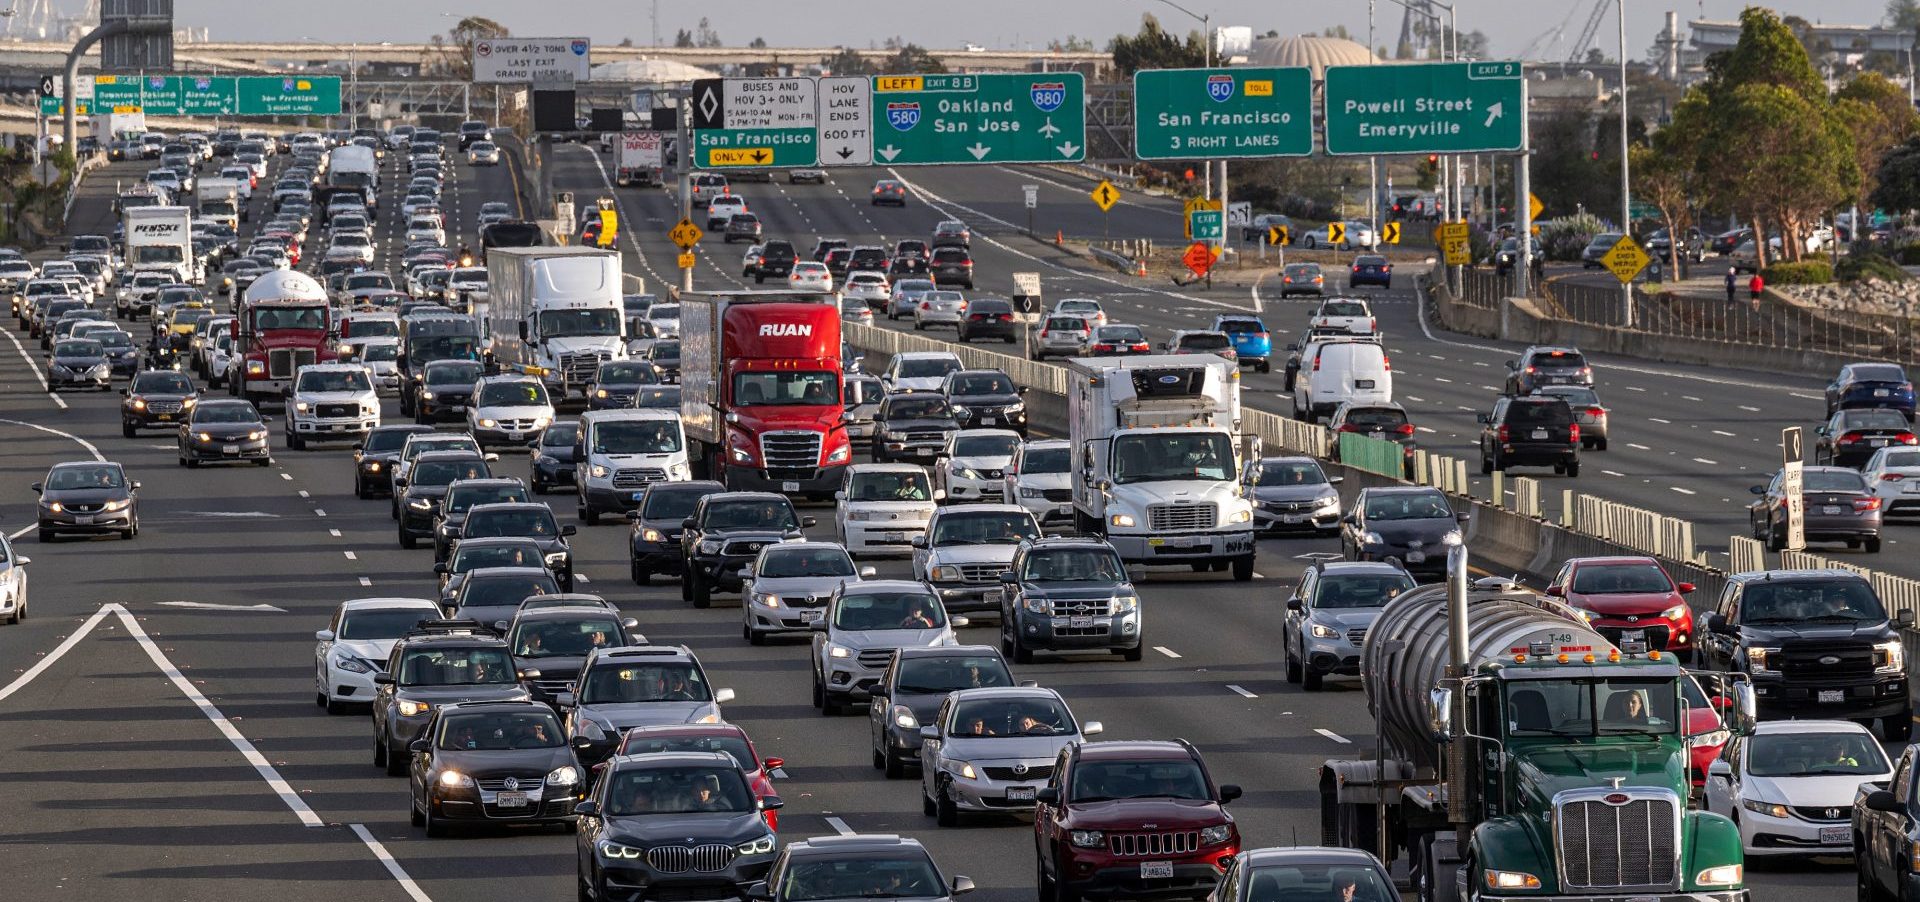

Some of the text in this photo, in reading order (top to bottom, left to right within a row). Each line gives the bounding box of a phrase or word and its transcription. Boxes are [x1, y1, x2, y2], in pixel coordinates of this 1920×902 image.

[495, 46, 518, 54] OVER
[544, 45, 566, 53] TONS
[508, 59, 530, 67] LAST
[496, 70, 527, 78] GRAND
[1479, 65, 1513, 75] EXIT 9
[743, 82, 799, 92] BUSES AND
[883, 78, 972, 89] LEFT EXIT 8 B
[1250, 84, 1268, 92] TOLL
[833, 85, 856, 94] HOV
[1212, 83, 1230, 96] 80
[735, 96, 755, 104] HOV
[779, 95, 804, 104] ONLY
[830, 98, 859, 108] LANE
[1036, 92, 1061, 105] 880
[938, 99, 1013, 113] Oakland
[1345, 98, 1472, 114] Powell Street
[830, 112, 859, 121] ENDS
[892, 111, 917, 125] 580
[1158, 111, 1291, 126] San Francisco
[934, 119, 1020, 133] San Jose
[1359, 121, 1460, 138] Emeryville
[701, 133, 811, 146] San Francisco
[824, 130, 866, 139] 600 FT
[626, 142, 660, 150] TARGET
[1171, 135, 1280, 149] 3 RIGHT LANES
[714, 153, 744, 162] ONLY
[1197, 214, 1217, 223] EXIT
[135, 224, 181, 233] PENSKE
[1201, 227, 1207, 236] 9
[759, 324, 812, 336] RUAN
[1549, 634, 1572, 642] T-49
